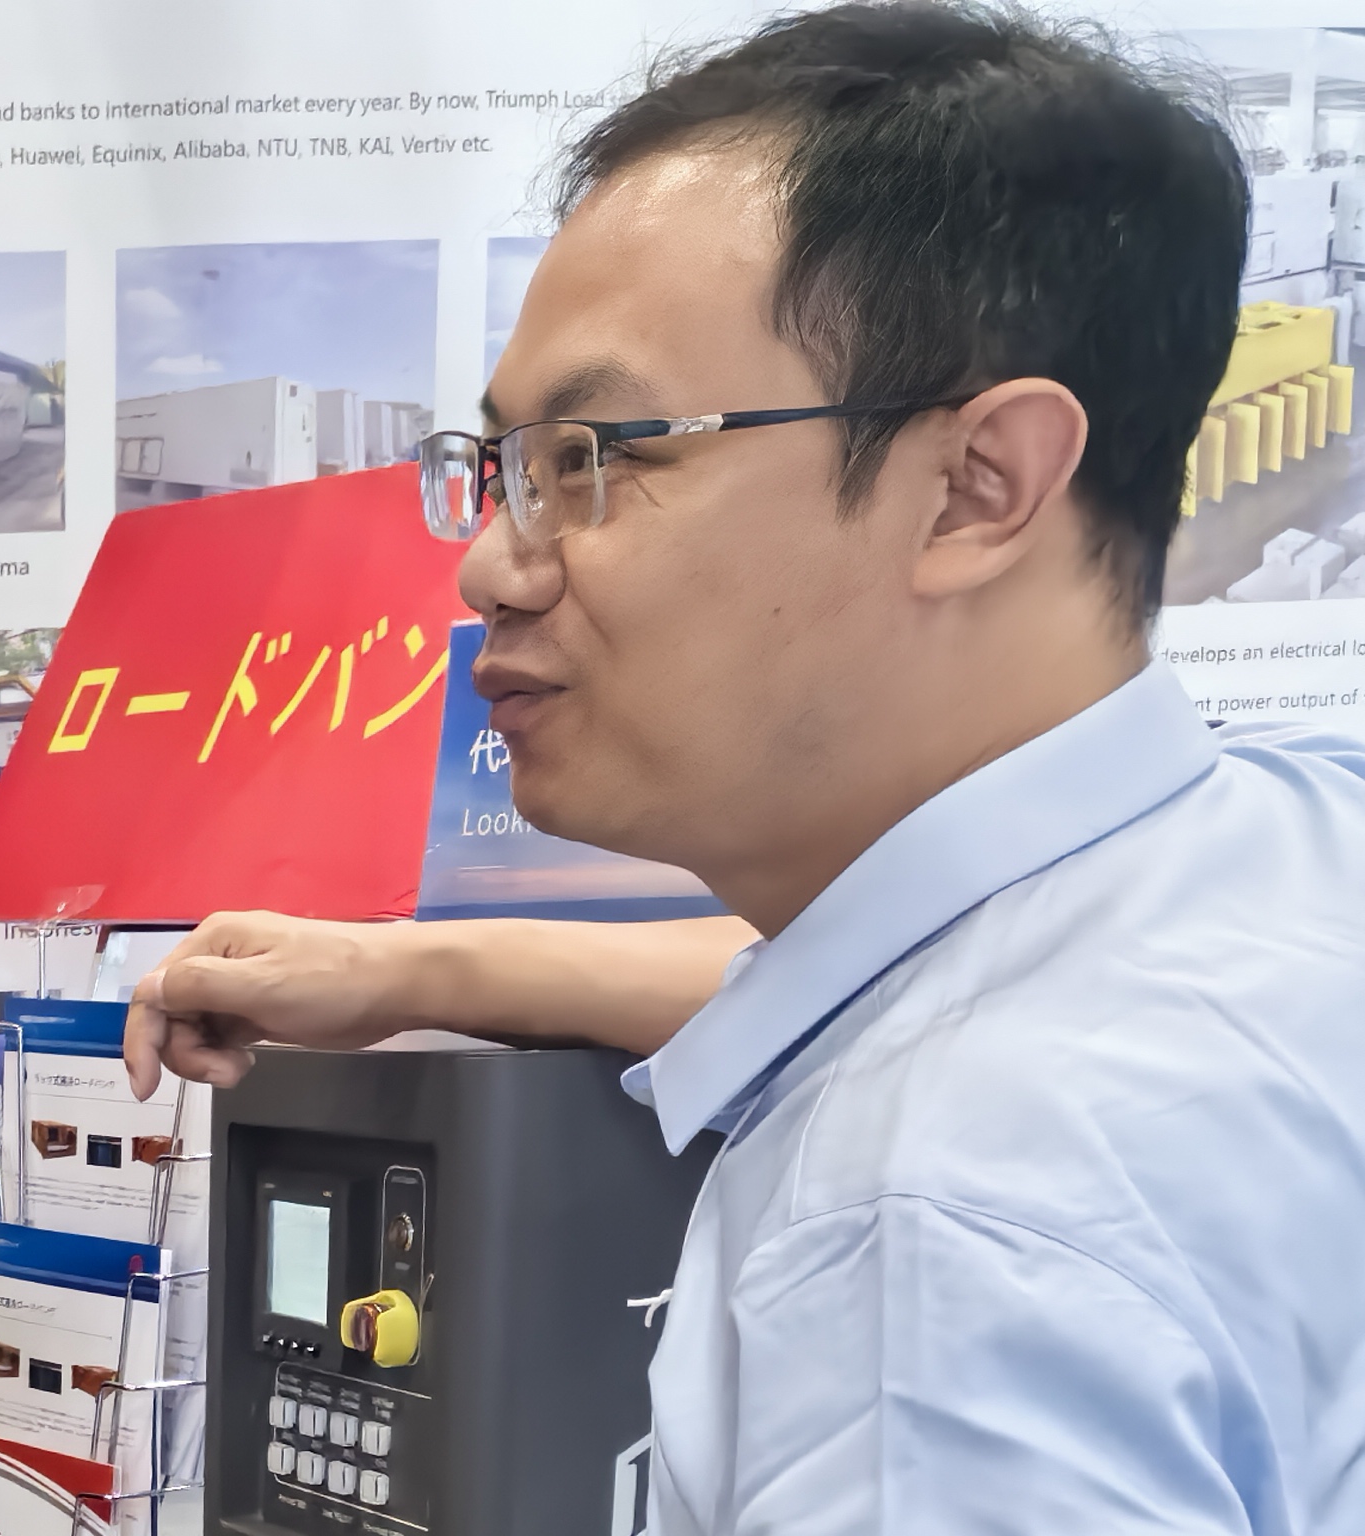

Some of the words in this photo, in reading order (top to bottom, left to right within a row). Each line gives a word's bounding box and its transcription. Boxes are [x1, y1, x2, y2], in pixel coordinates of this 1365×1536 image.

[20, 100, 75, 121] banks
[81, 102, 100, 120] to
[106, 95, 229, 119] international
[236, 94, 300, 115] market
[305, 98, 356, 118] every
[360, 98, 403, 117] year.
[409, 92, 432, 115] By
[437, 95, 479, 112] now,
[485, 90, 559, 113] Triumph
[564, 91, 605, 109] Load
[11, 146, 85, 168] Huawei,
[92, 144, 167, 168] Equinix,
[174, 139, 251, 160] Alibaba,
[257, 139, 302, 159] NTU,
[310, 137, 352, 158] TNB,
[402, 135, 455, 155] Vertiv
[1243, 648, 1263, 661] an
[1270, 640, 1346, 660] electrical
[47, 615, 450, 764] ロードバン
[1218, 696, 1272, 715] power
[1279, 693, 1336, 711] output
[1341, 688, 1359, 706] of
